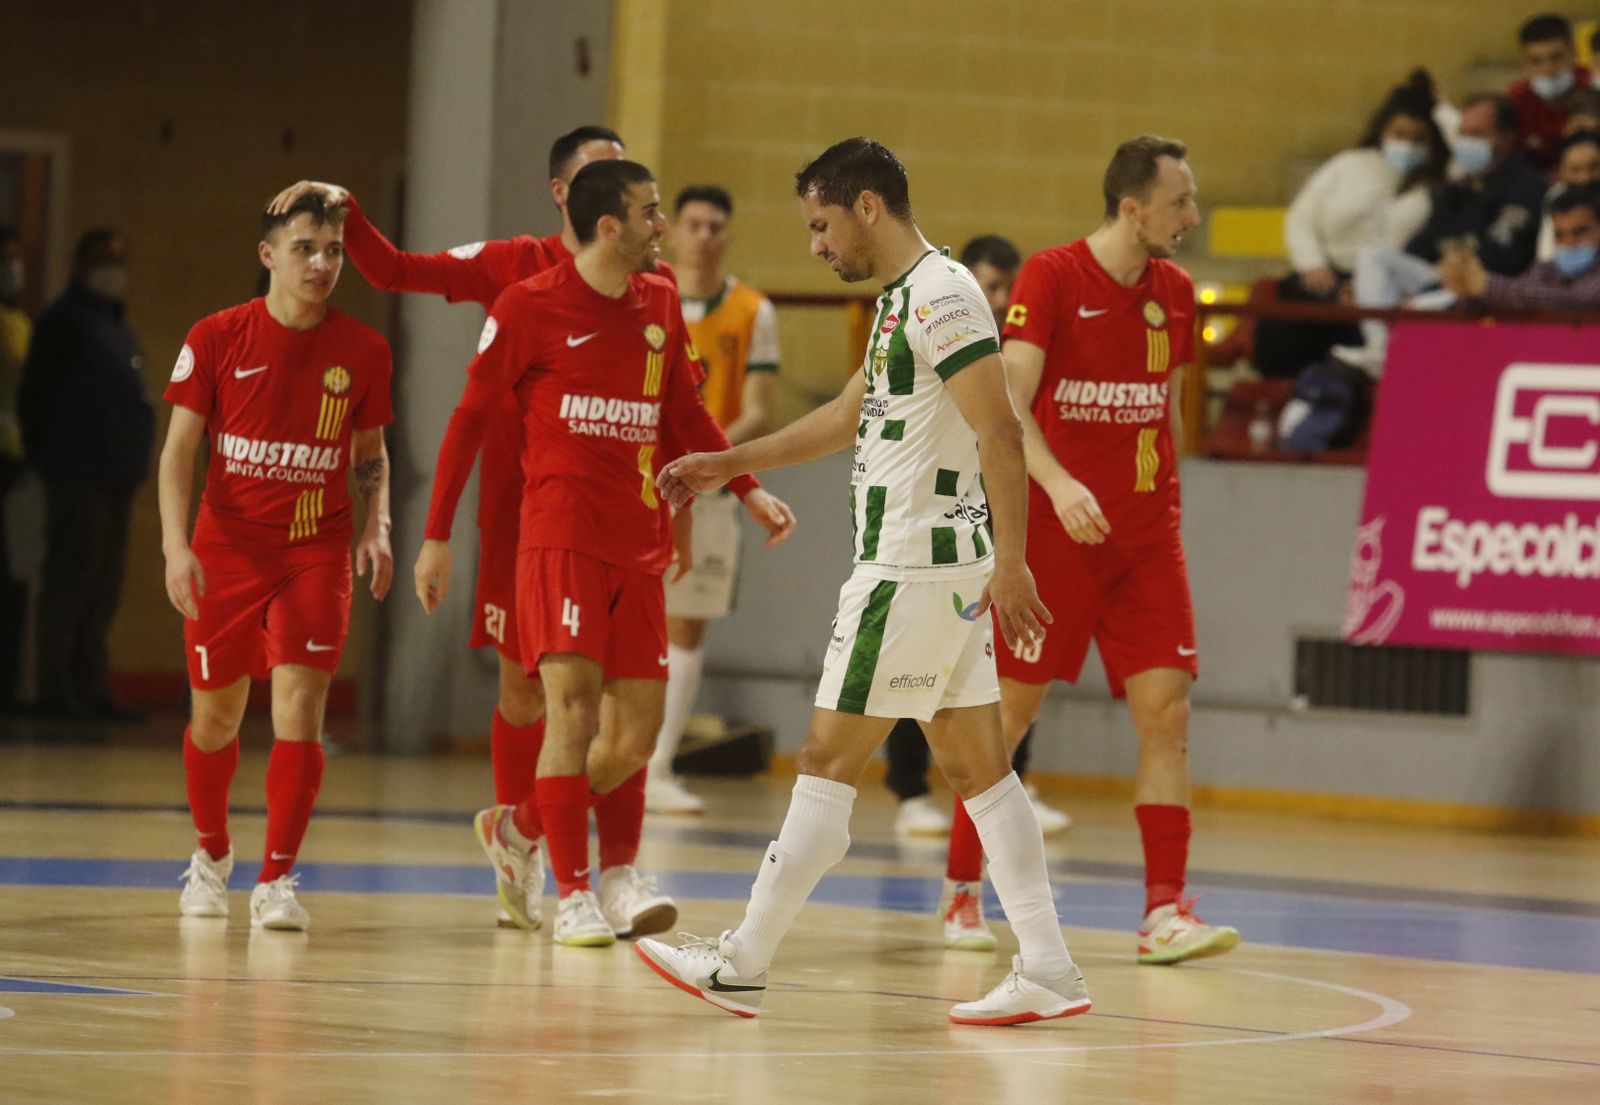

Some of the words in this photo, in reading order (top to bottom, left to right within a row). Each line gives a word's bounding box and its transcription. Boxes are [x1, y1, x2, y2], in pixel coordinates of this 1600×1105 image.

[931, 308, 970, 330] IMDECO
[1059, 404, 1111, 423] SANTA
[568, 420, 619, 440] SANTA
[217, 431, 341, 471] INDUSTRIAS
[225, 459, 265, 480] SANTA
[266, 465, 327, 485] COLOMA
[484, 603, 506, 644] 21
[561, 597, 580, 637] 4
[889, 672, 938, 689] efficold
